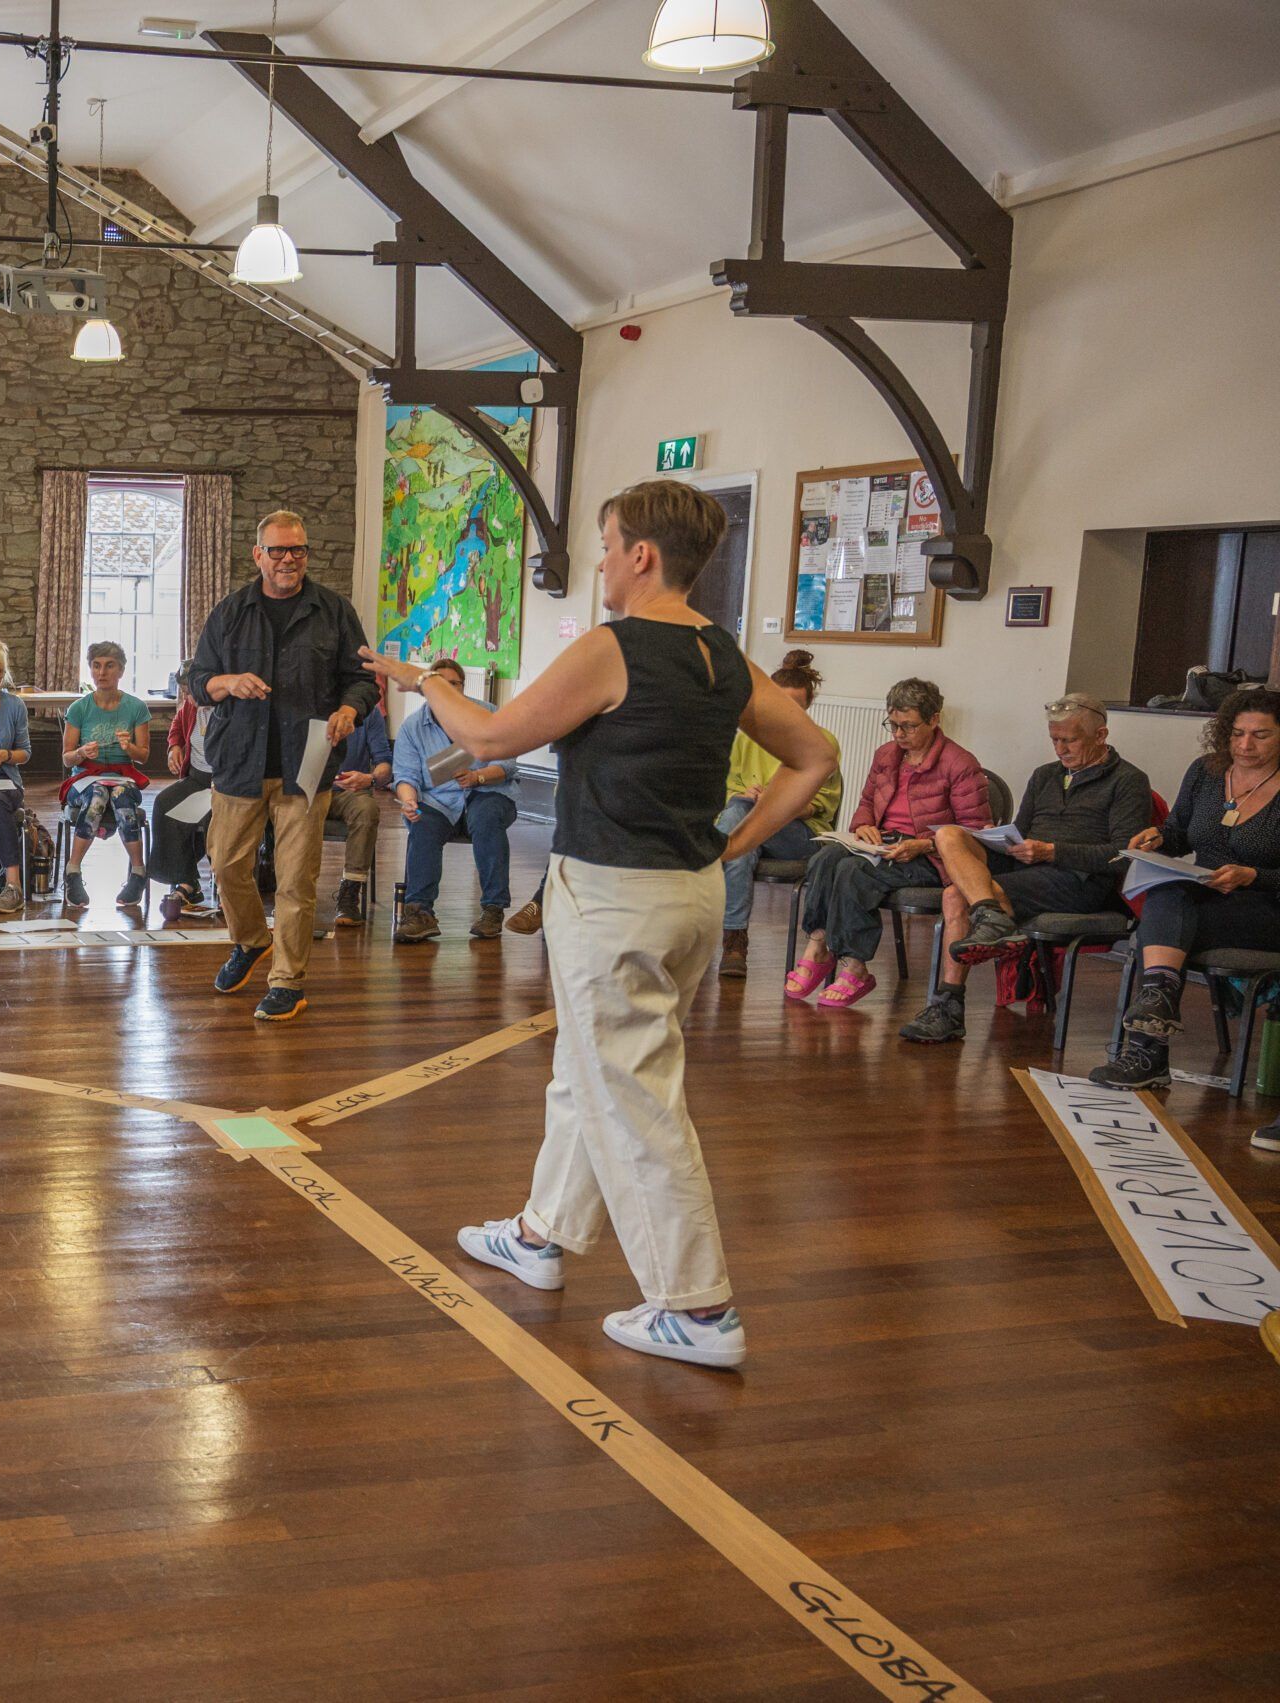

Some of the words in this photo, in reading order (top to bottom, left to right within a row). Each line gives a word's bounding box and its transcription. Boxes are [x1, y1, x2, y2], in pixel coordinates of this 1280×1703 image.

[513, 1021, 549, 1033] UK
[405, 1055, 471, 1079] WALES
[319, 1090, 386, 1113] LOCAL
[278, 1164, 343, 1211] LOCAL
[387, 1254, 473, 1312] WALES
[566, 1397, 634, 1442] UK
